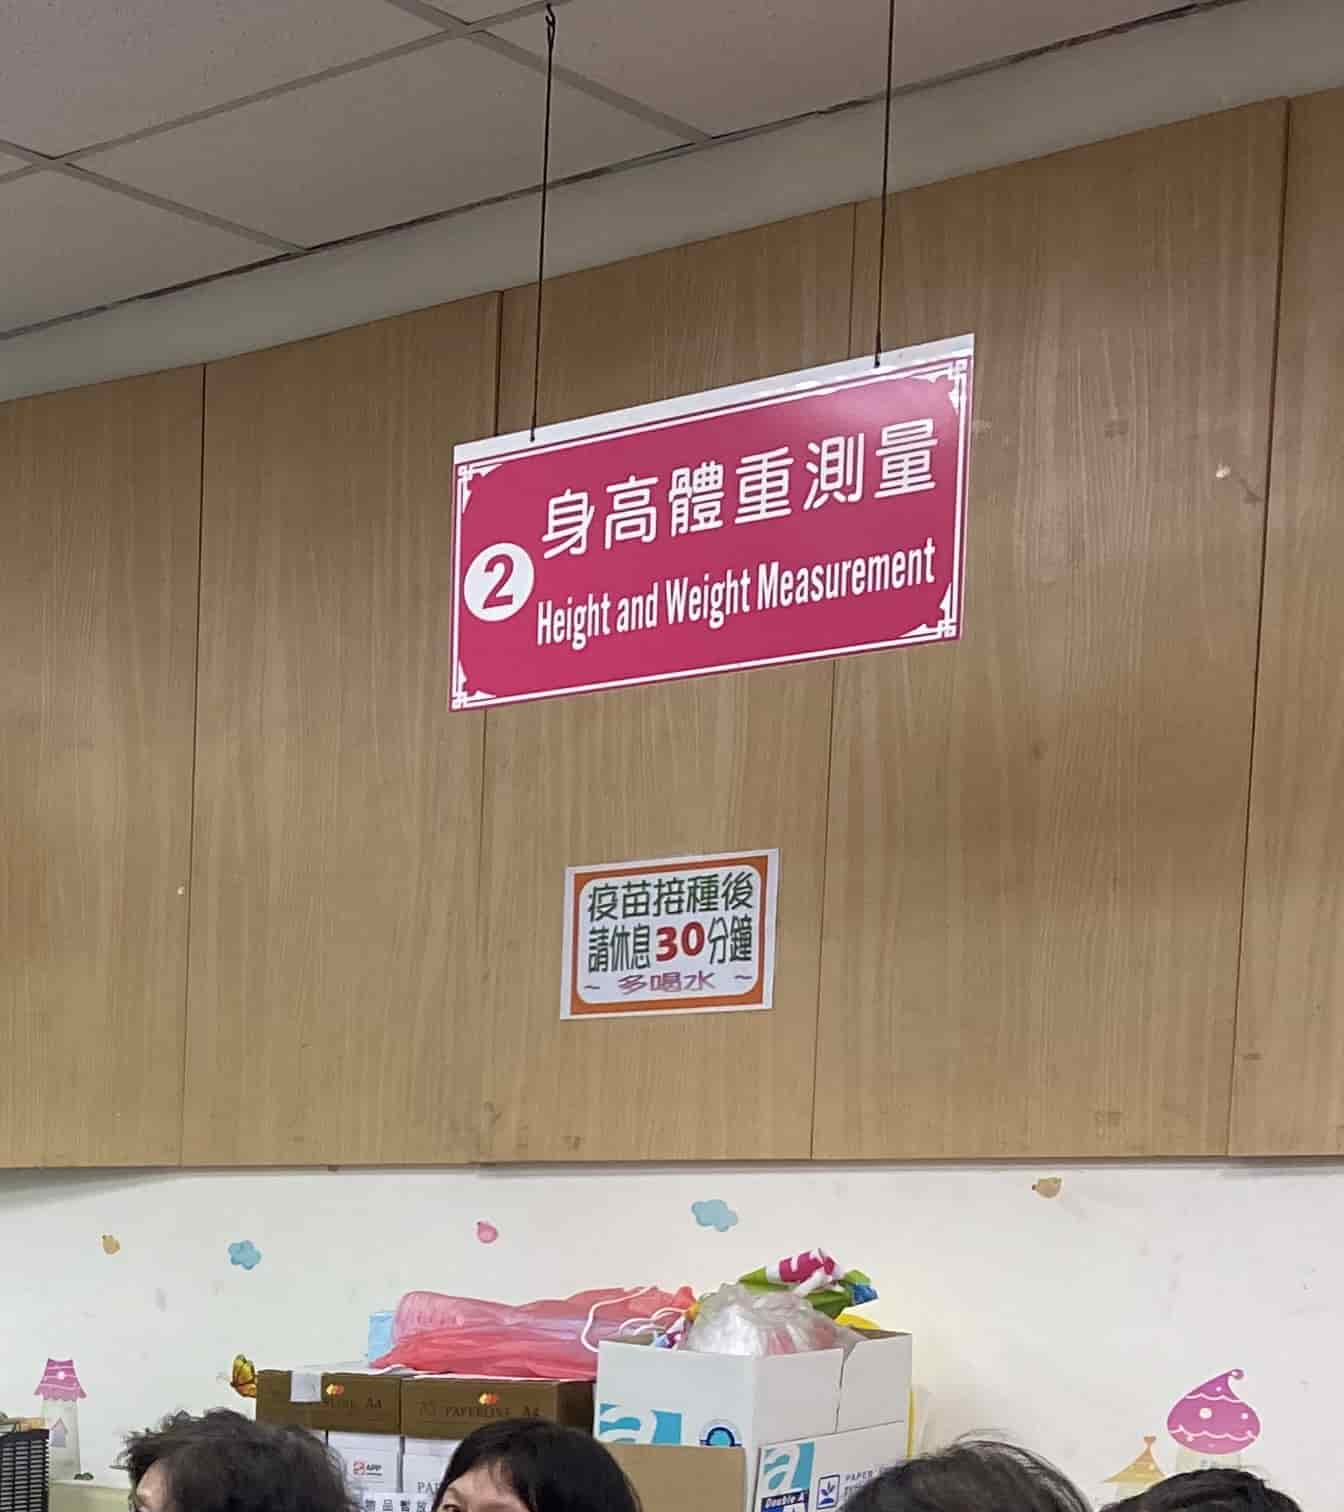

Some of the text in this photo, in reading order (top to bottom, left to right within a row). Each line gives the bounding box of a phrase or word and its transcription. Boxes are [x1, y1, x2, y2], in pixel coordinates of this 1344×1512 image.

[541, 418, 939, 560] 身高體重測量
[480, 552, 514, 610] 2
[536, 537, 936, 651] Height and Weight Measurement
[587, 871, 754, 923] 疫苗接種後
[587, 915, 753, 973] 請休息30分鐘
